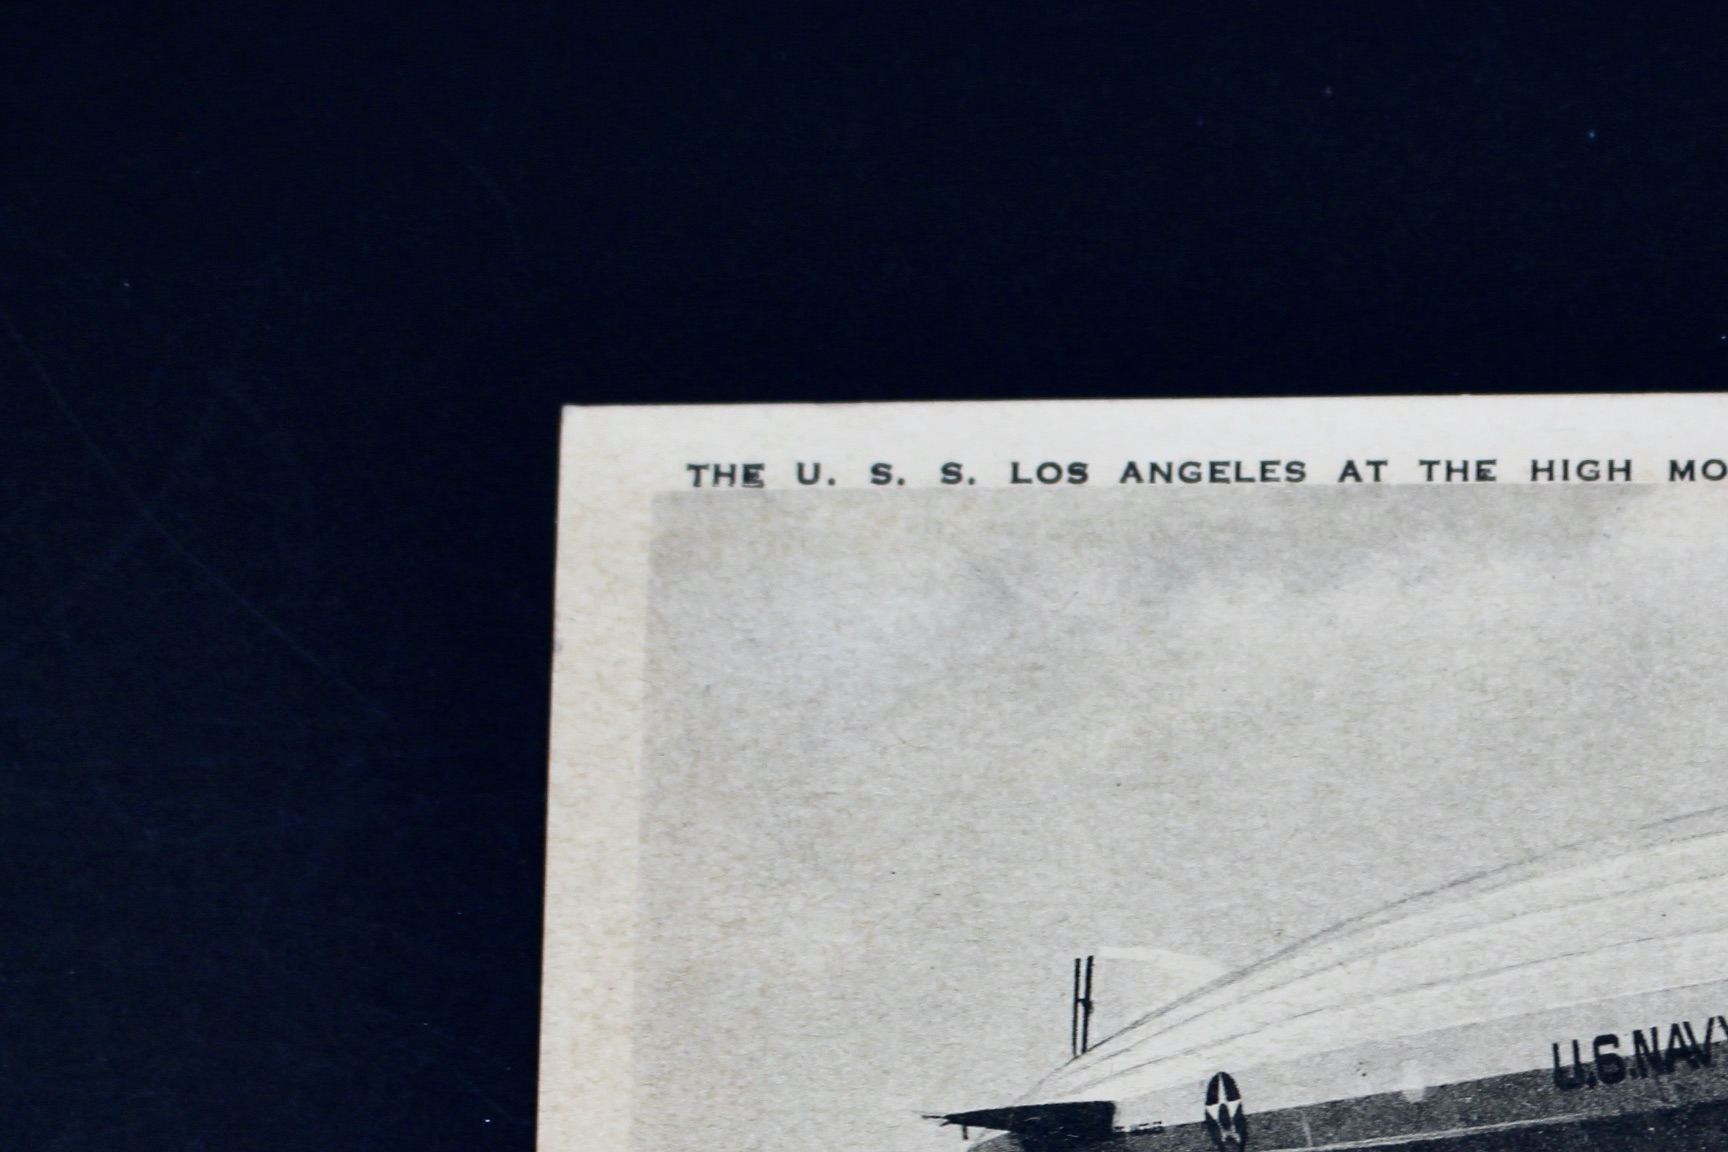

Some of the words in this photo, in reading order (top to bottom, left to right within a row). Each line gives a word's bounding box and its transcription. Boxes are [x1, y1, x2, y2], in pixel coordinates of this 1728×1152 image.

[686, 463, 764, 488] THE
[796, 462, 837, 486] U.
[870, 462, 905, 487] S.
[940, 461, 976, 486] S.
[1010, 461, 1089, 485] LOS
[1119, 460, 1307, 485] ANGELES
[1338, 459, 1389, 483] AT
[1418, 459, 1497, 482] THE
[1530, 458, 1633, 482] HIGH
